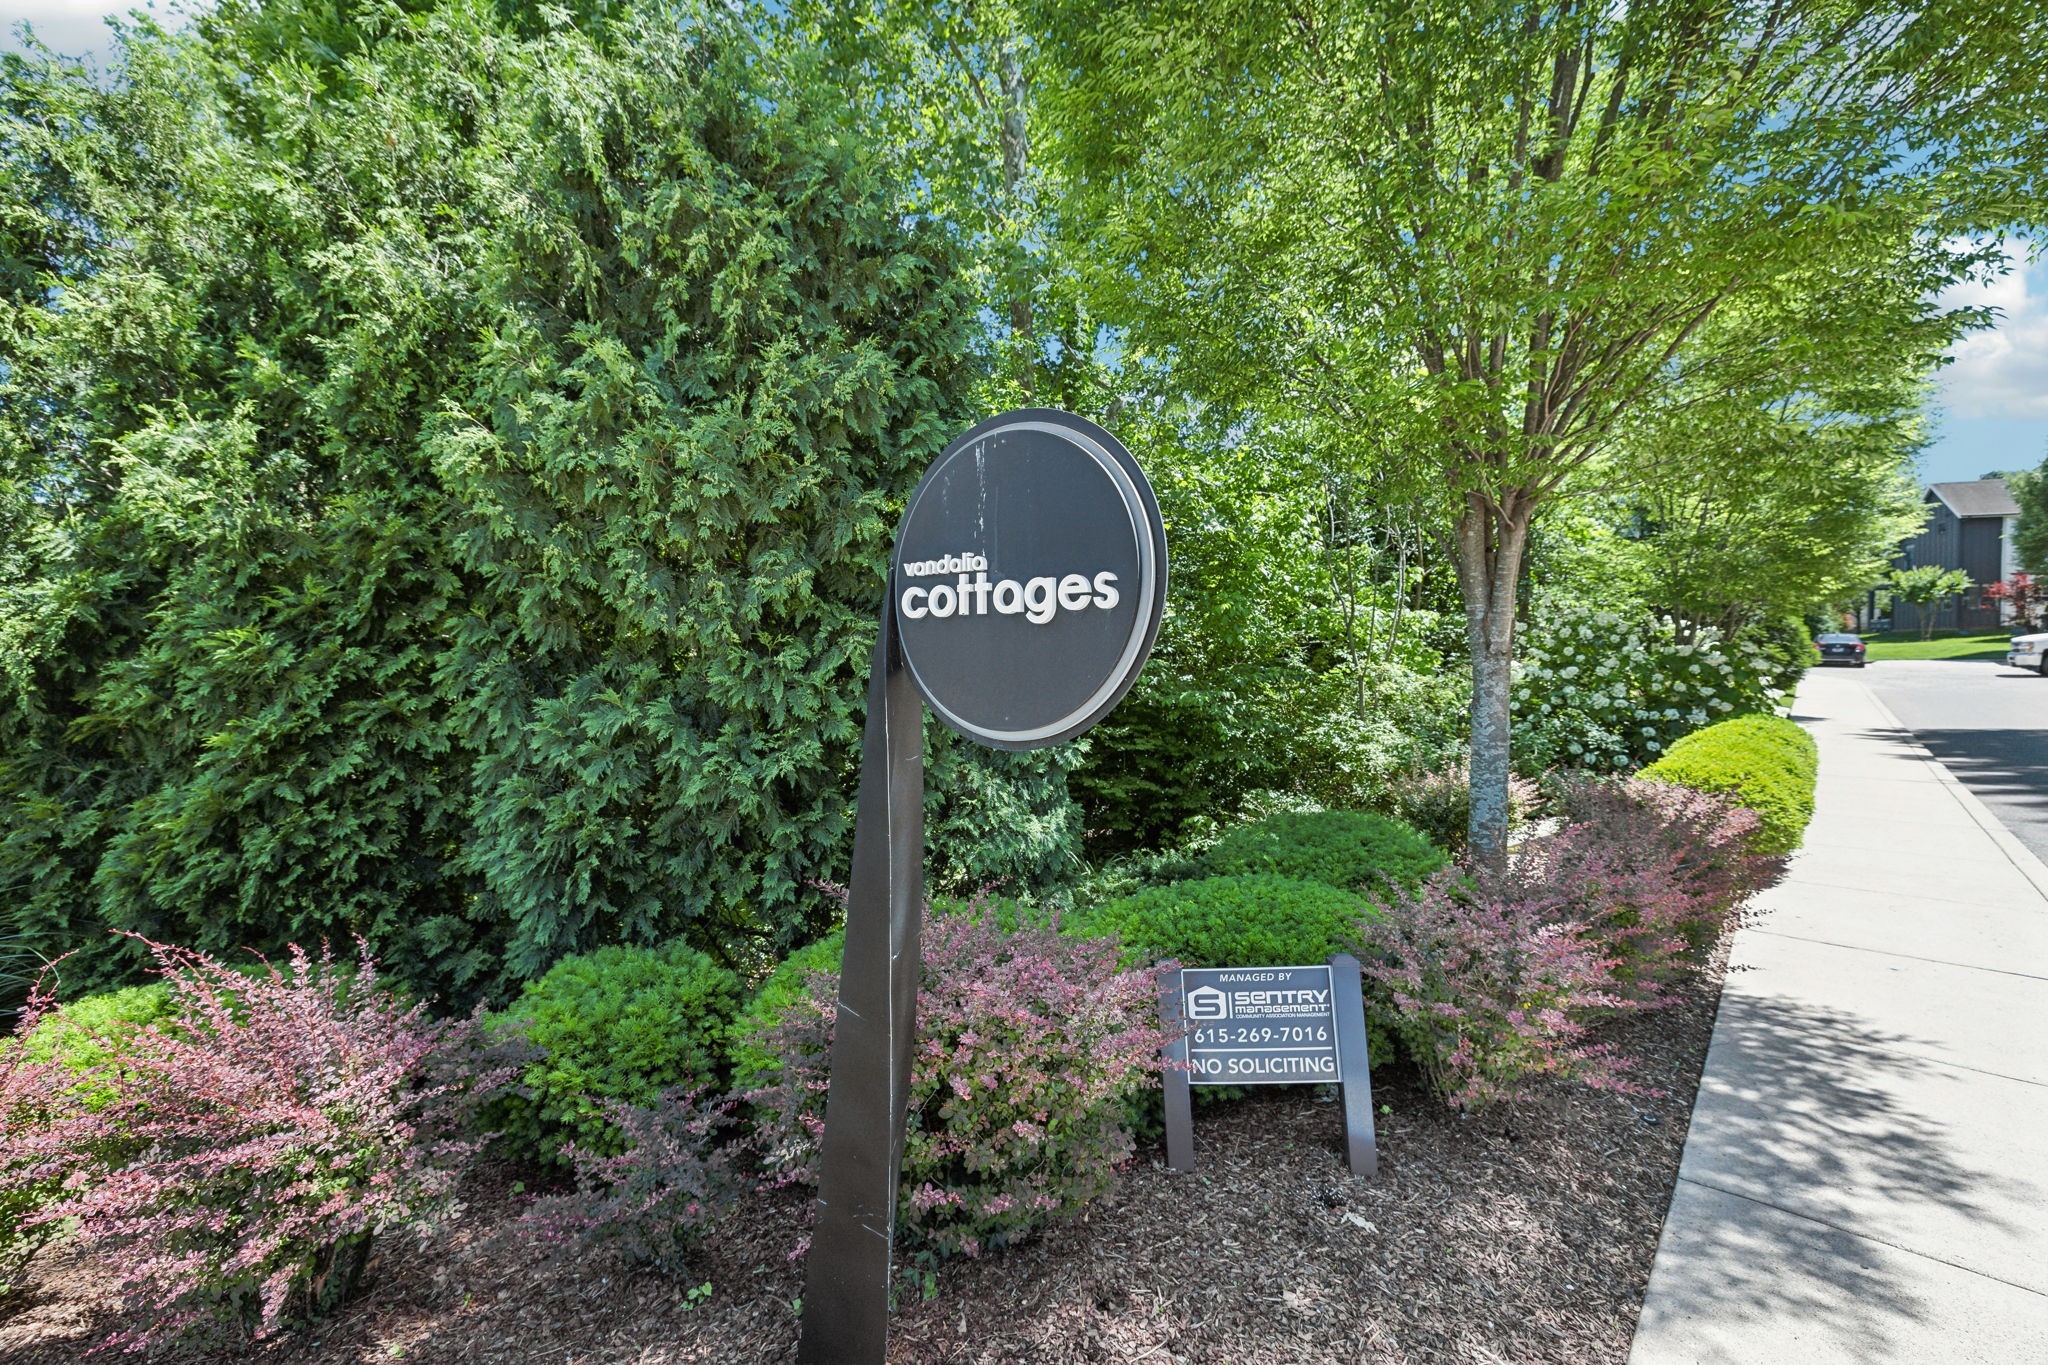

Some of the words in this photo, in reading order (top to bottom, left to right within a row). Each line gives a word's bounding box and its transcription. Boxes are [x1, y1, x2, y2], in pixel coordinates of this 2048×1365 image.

[903, 552, 988, 577] vandalia
[901, 571, 1120, 625] cottages
[1219, 972, 1275, 982] MANAGED
[1278, 972, 1292, 981] BY
[1194, 1026, 1328, 1043] 615-269-7016
[1191, 1058, 1222, 1074] NO
[1228, 1056, 1335, 1074] SOLICITING
